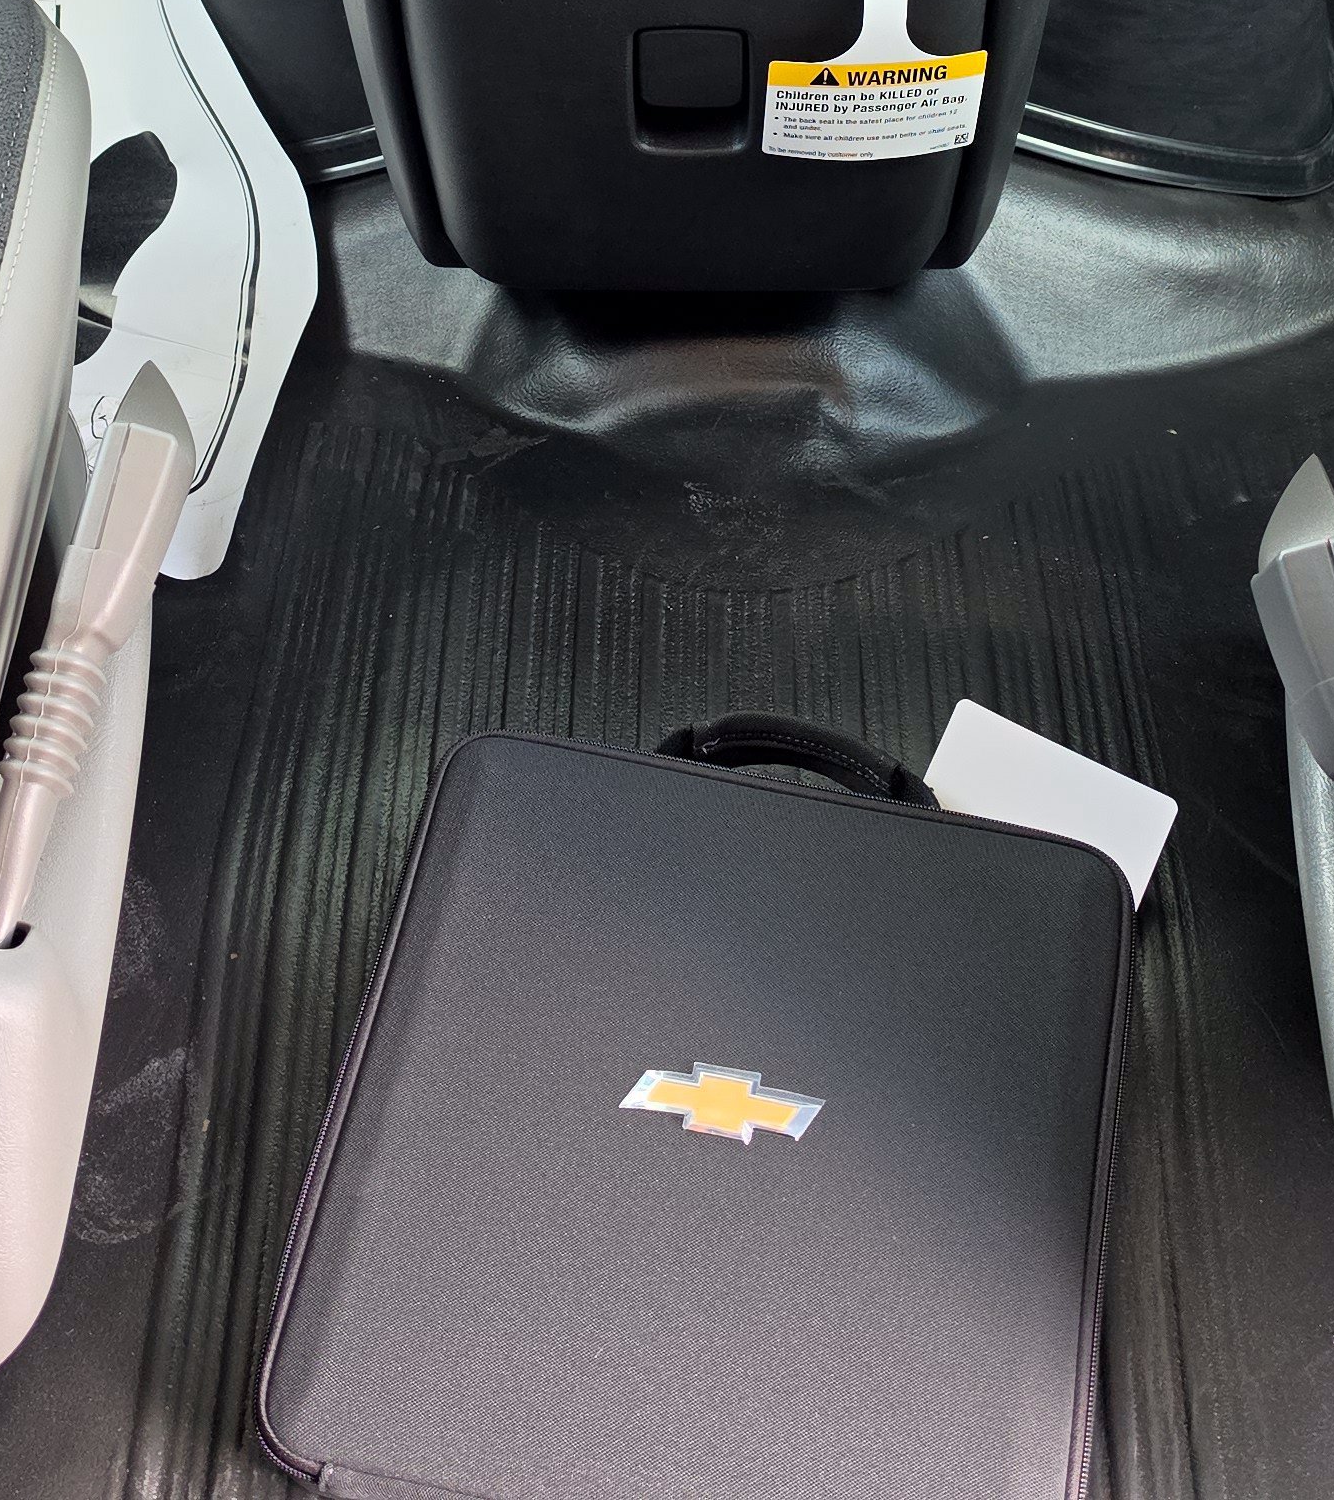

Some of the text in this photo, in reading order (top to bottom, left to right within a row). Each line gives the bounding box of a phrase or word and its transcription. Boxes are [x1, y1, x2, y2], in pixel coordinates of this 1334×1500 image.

[847, 65, 947, 86] WARNING
[776, 90, 829, 101] Children
[860, 92, 875, 101] be
[879, 88, 922, 100] KILLED
[927, 88, 940, 96] or
[775, 101, 829, 112] INJURED
[834, 104, 848, 114] by
[852, 101, 917, 113] Passenger
[921, 98, 938, 108] Air
